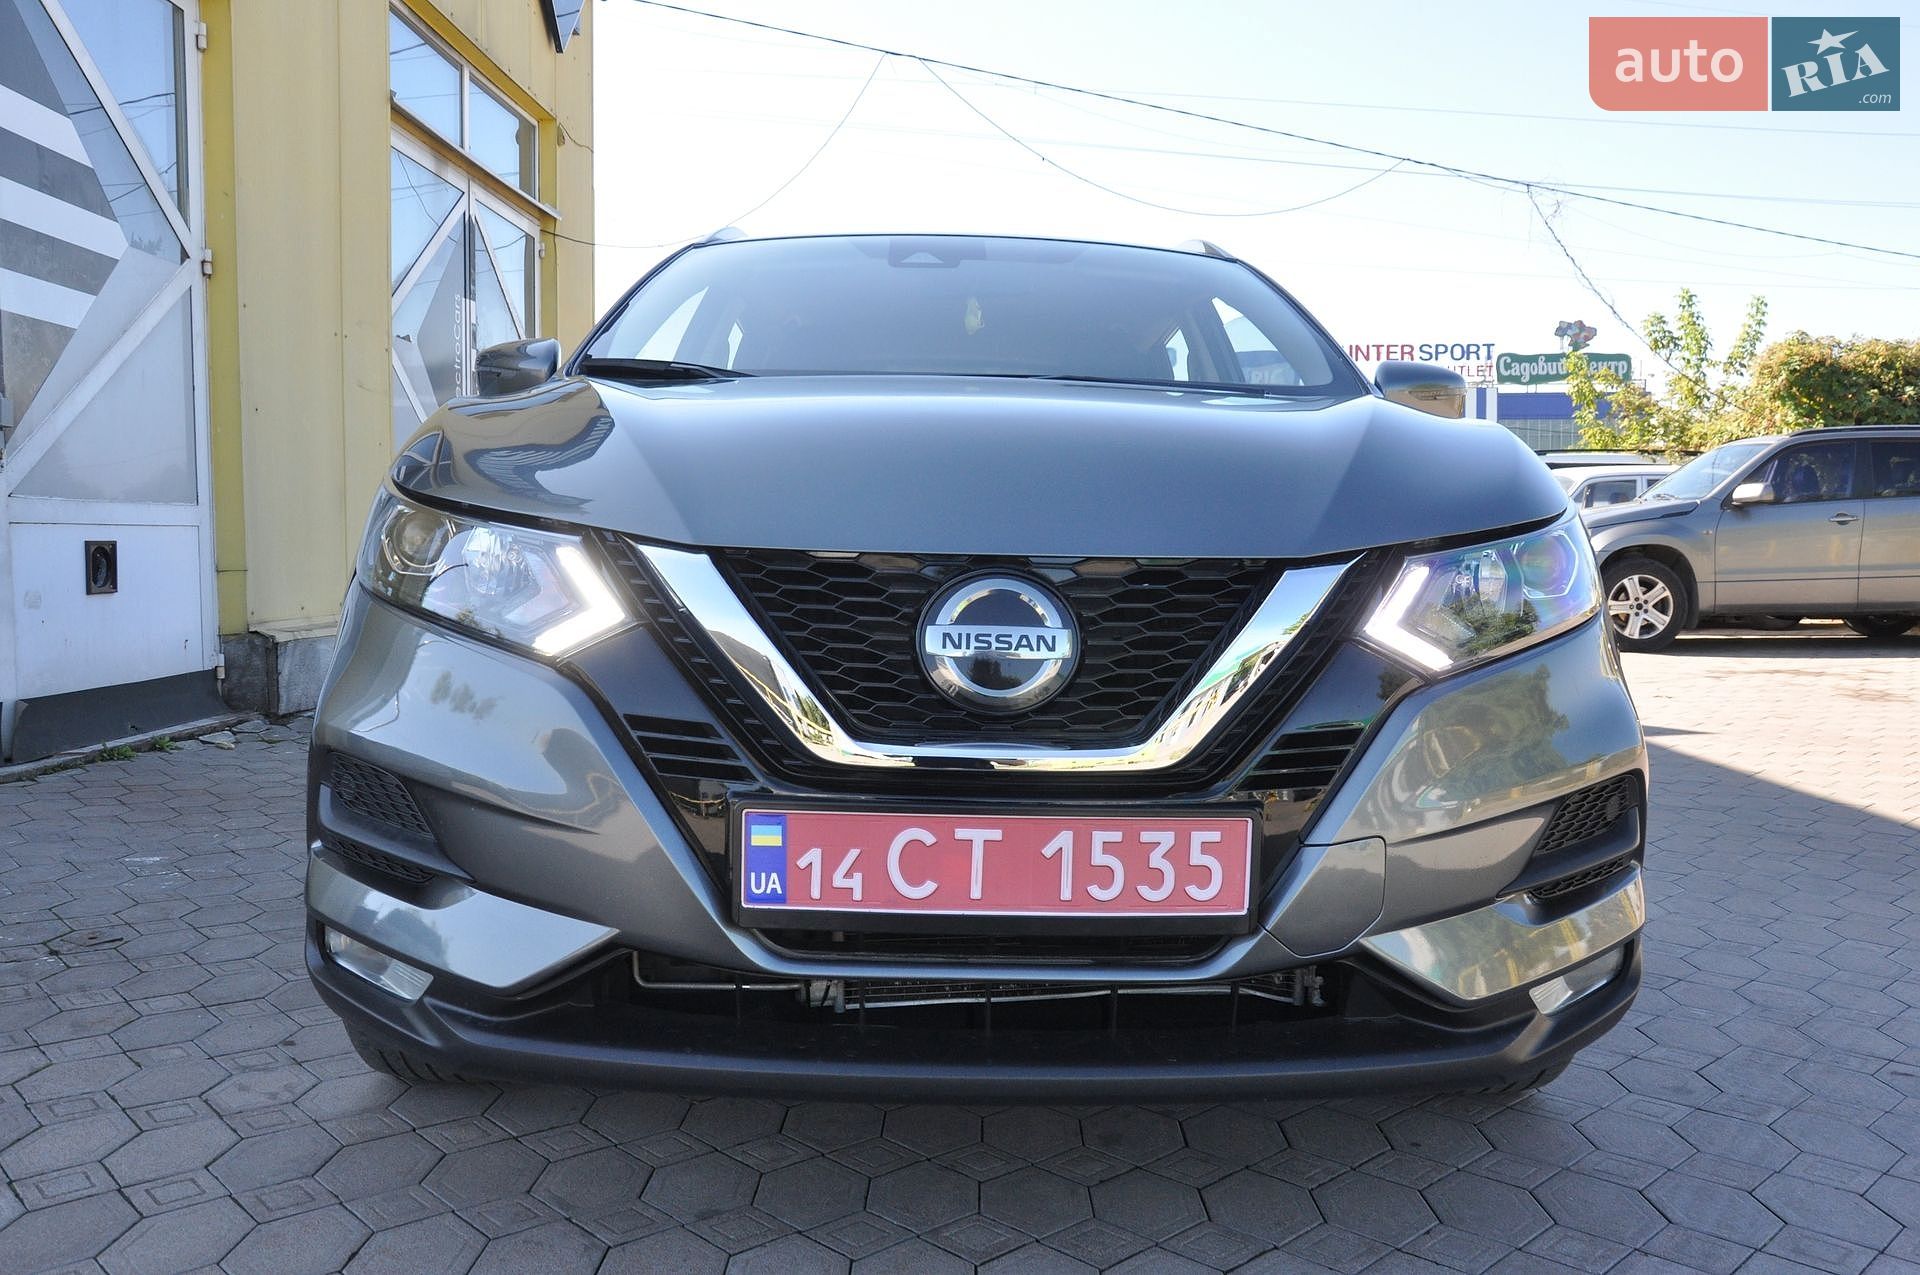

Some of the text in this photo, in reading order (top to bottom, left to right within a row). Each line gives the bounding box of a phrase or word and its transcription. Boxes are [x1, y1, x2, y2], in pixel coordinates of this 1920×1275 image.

[1580, 360, 1628, 378] ентр
[941, 632, 1057, 652] NISSAN
[796, 847, 863, 901] 14
[1041, 830, 1223, 902] 1535
[750, 872, 782, 895] UA
